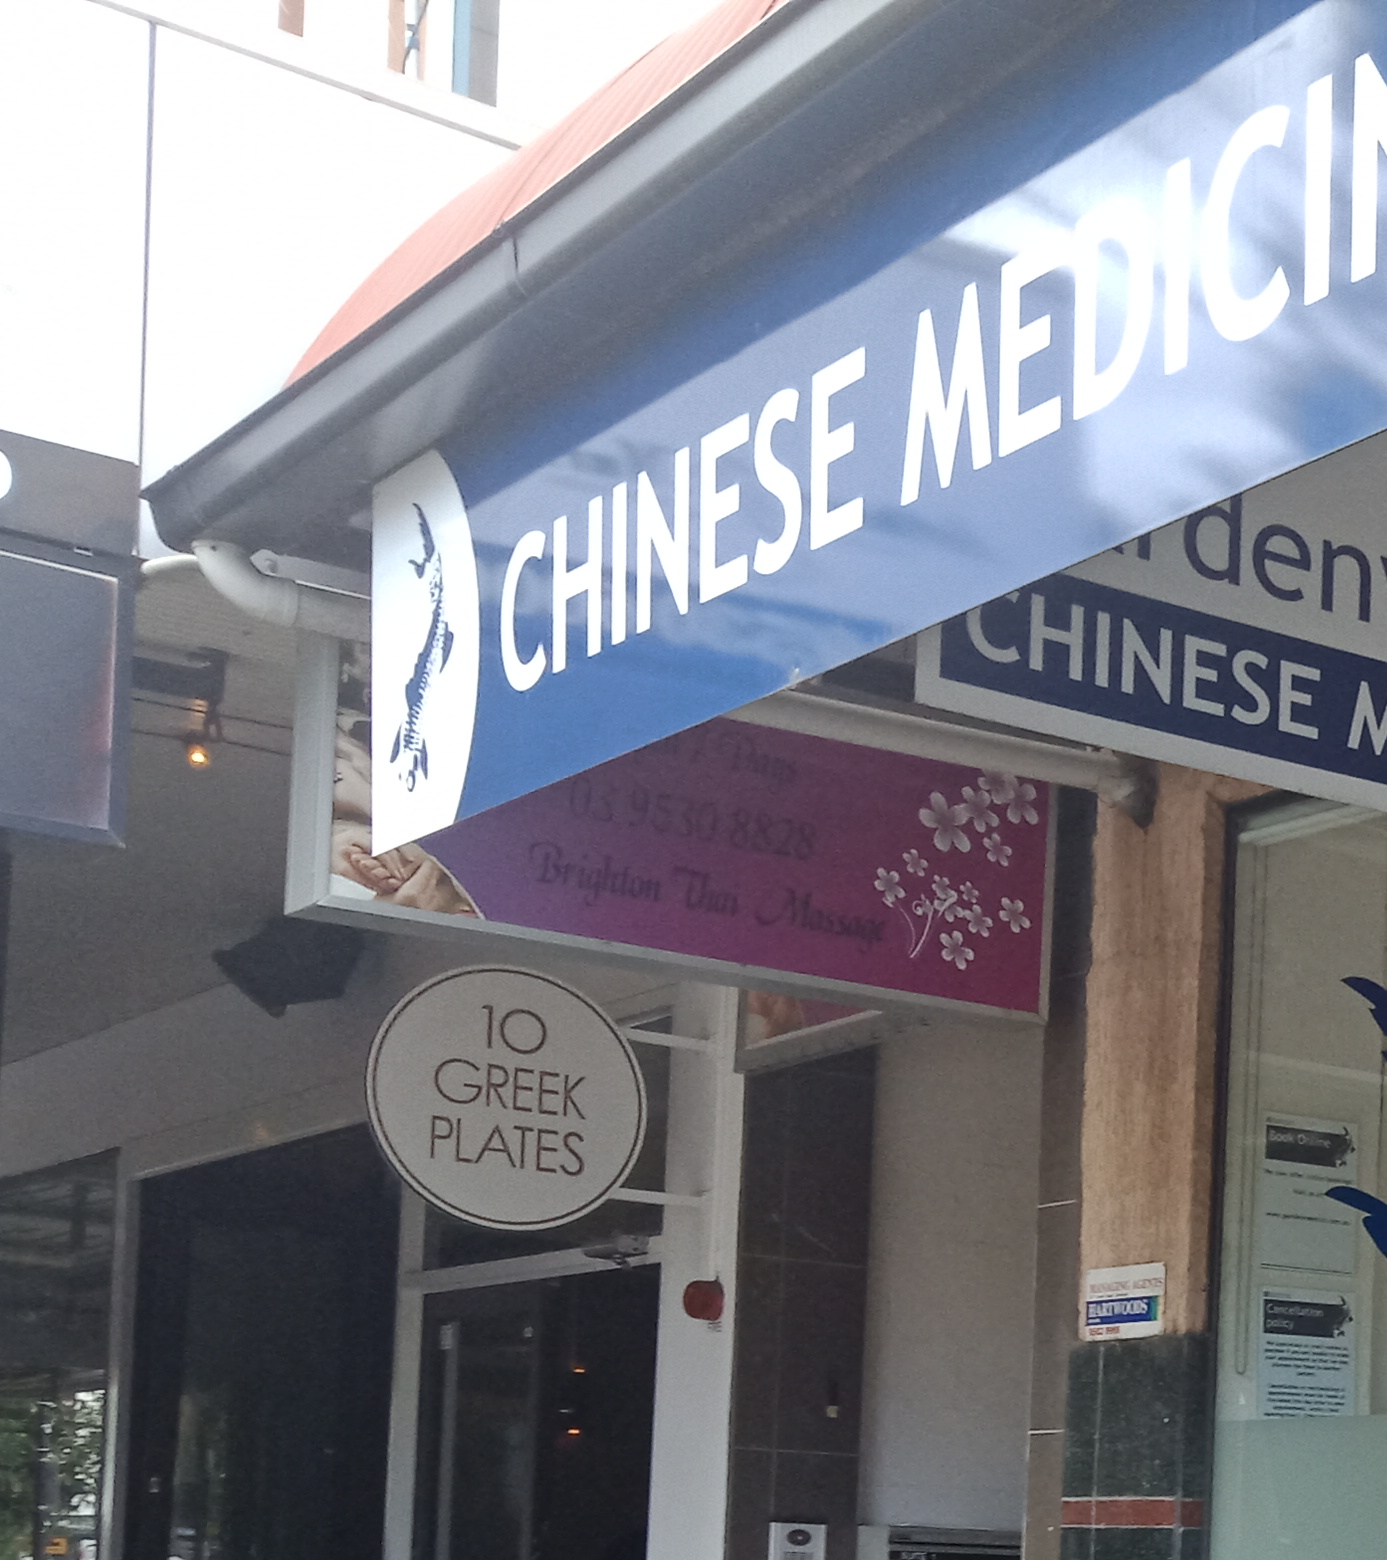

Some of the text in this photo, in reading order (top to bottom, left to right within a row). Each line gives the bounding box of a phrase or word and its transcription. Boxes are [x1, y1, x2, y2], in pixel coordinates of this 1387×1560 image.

[500, 346, 865, 693] CHINESE
[966, 590, 1320, 740] CHINESE
[482, 1005, 546, 1054] 10
[434, 1058, 586, 1120] GREEK
[430, 1115, 585, 1176] PLATES
